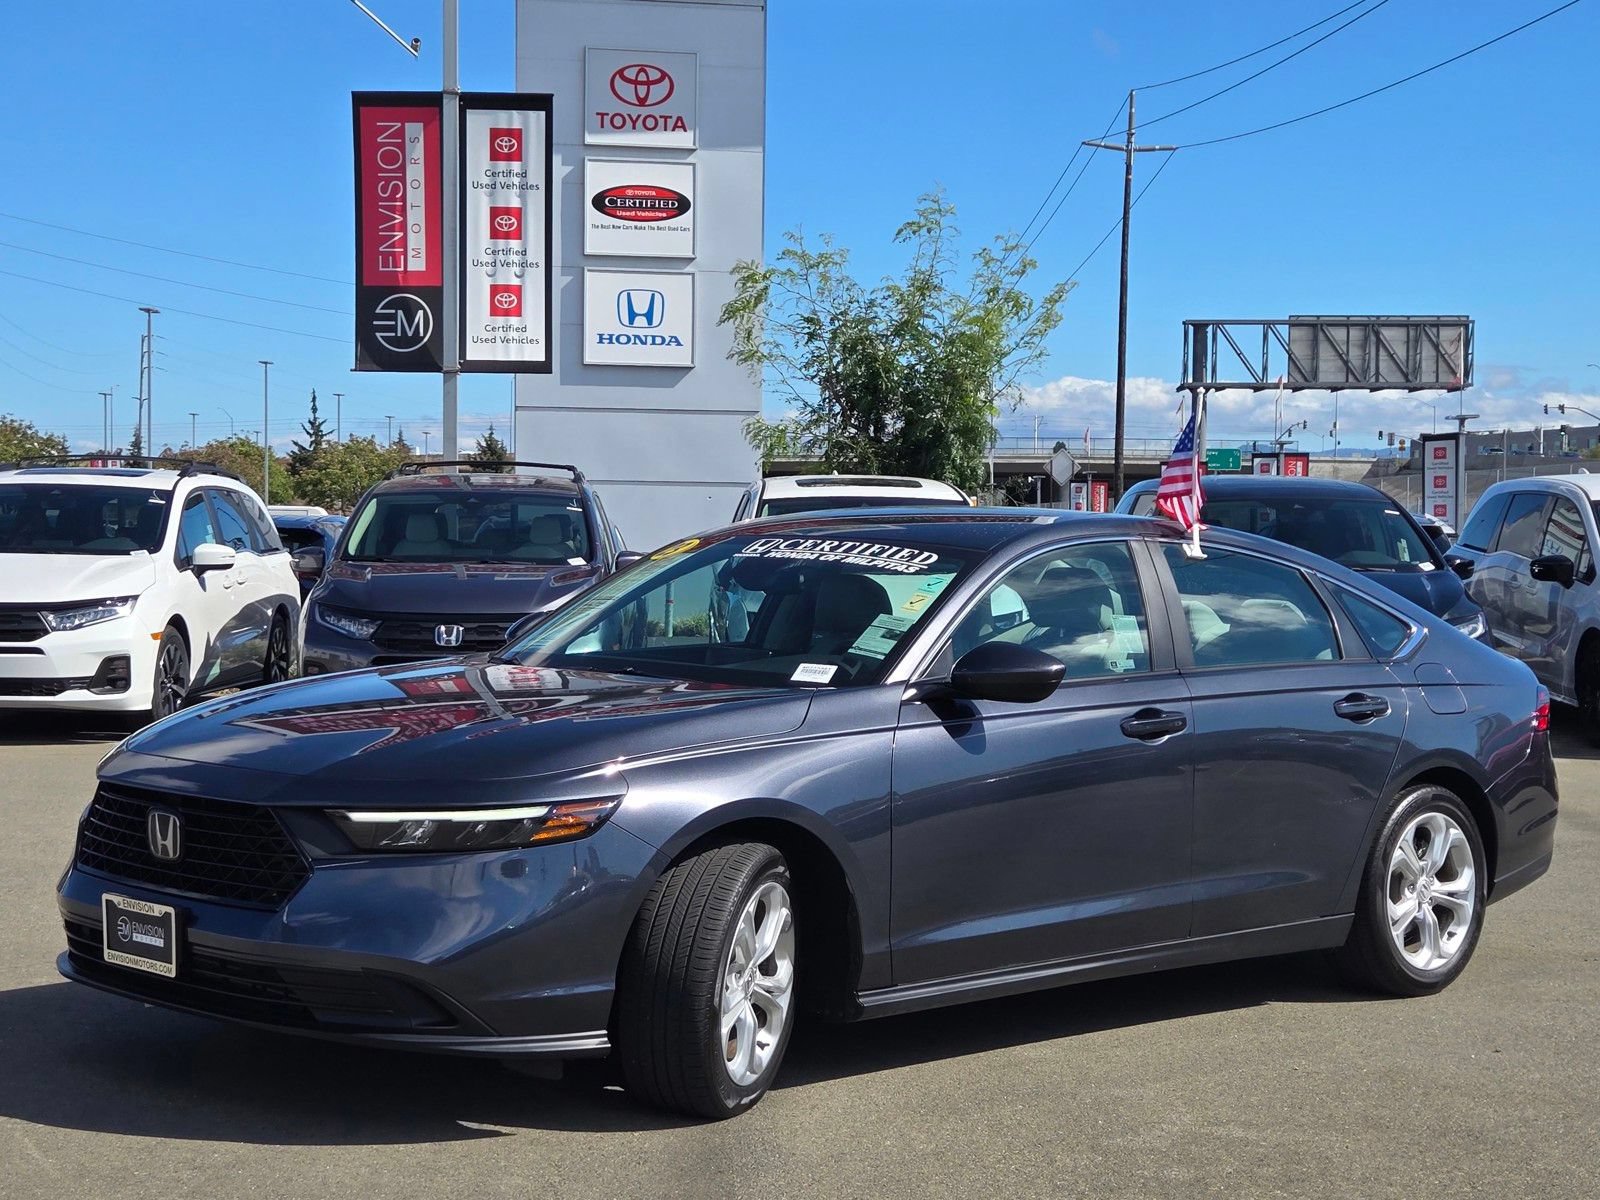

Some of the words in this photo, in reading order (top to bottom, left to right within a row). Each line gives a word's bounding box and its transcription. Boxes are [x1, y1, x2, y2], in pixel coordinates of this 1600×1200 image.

[595, 111, 688, 133] TOYOTA
[484, 169, 527, 178] Certified
[472, 181, 497, 190] Used
[499, 181, 540, 191] Vehicles
[376, 122, 405, 272] ENVISION
[409, 136, 422, 259] MOTORS
[604, 196, 679, 209] CERTIFIED
[484, 247, 527, 256] Certified
[472, 259, 497, 268] Used
[499, 259, 540, 269] Vehicles
[484, 324, 527, 333] Certified
[472, 335, 497, 344] Used
[499, 335, 540, 345] Vehicles
[596, 333, 684, 347] HONDA
[779, 539, 939, 565] CERTIFIED
[764, 551, 820, 560] HONDA
[818, 554, 846, 562] OF
[841, 556, 921, 573] MILPITAS
[122, 899, 155, 914] ENVISION
[132, 921, 165, 938] ENVISION
[107, 951, 173, 975] ENVISIONMOTORS.COM
